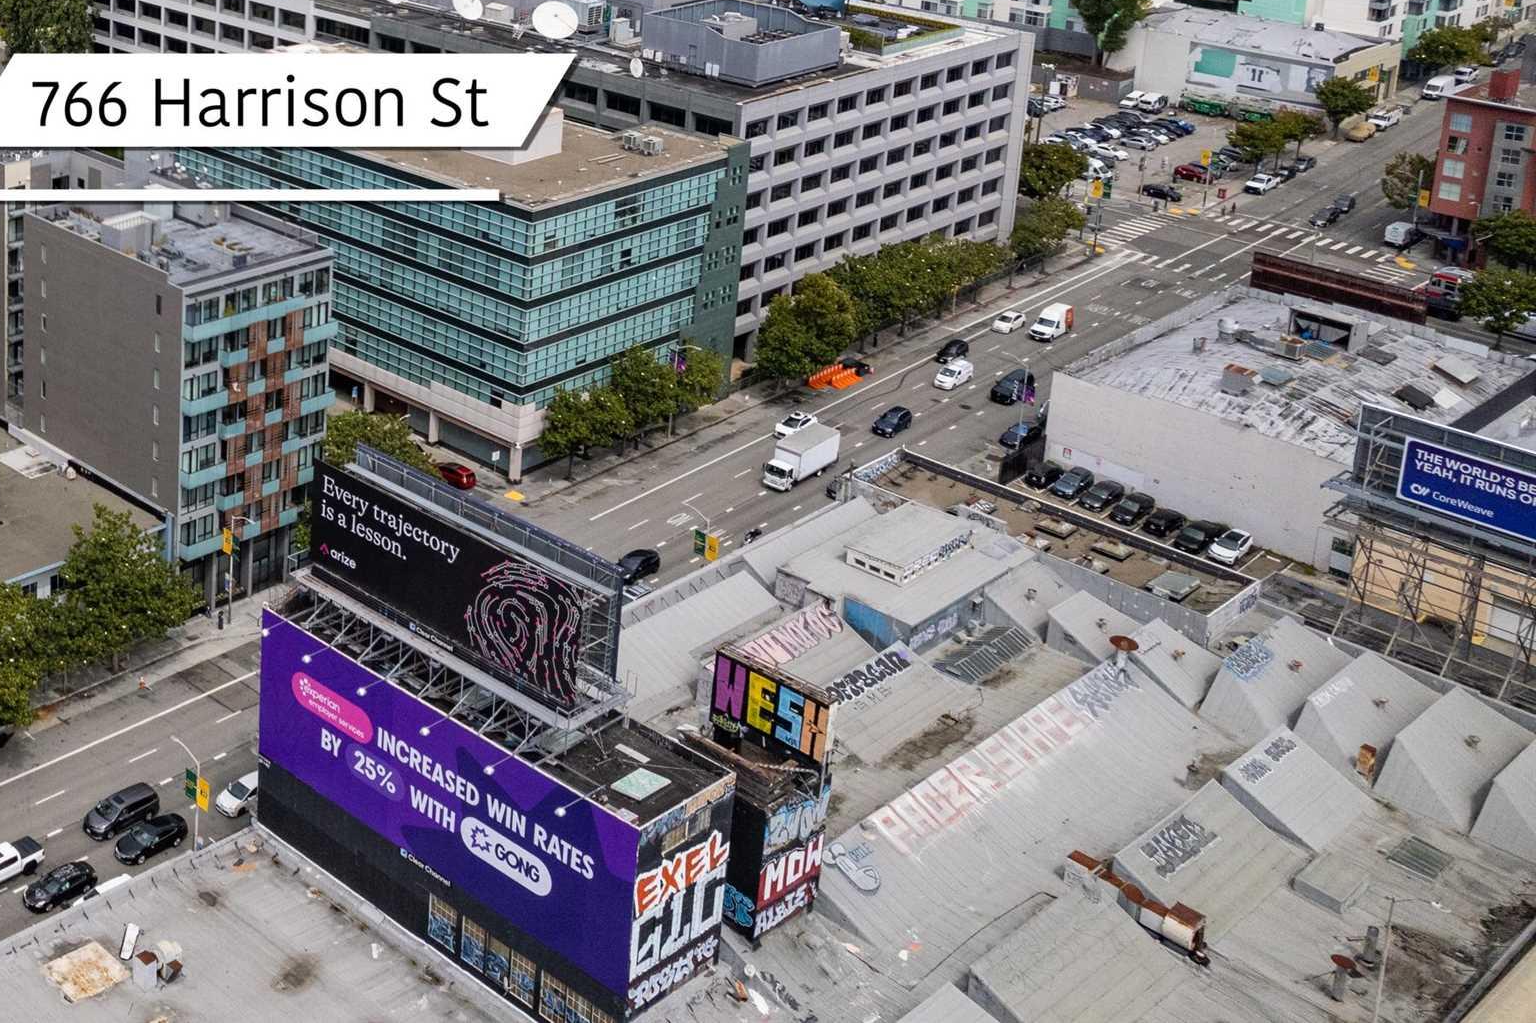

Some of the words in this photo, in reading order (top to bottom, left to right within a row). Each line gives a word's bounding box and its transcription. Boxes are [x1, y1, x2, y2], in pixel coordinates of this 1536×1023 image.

[1415, 449, 1443, 466] THE
[1445, 458, 1516, 488] WORLD'S
[1415, 459, 1456, 483] YEAH,
[1460, 474, 1474, 486] IT
[1475, 479, 1517, 501] RUNS
[320, 499, 336, 519] is
[337, 510, 347, 524] a
[351, 507, 407, 561] lesson.
[323, 475, 369, 518] Every
[373, 503, 460, 564] trajectory
[1432, 491, 1495, 518] CoreWeave
[330, 548, 357, 570] arize
[304, 685, 340, 714] experian
[714, 655, 830, 765] WESH
[320, 728, 342, 758] BY
[353, 750, 397, 795] 25%
[410, 785, 456, 834] WITH
[377, 727, 480, 807] INCREASED
[487, 795, 526, 838] WIN
[533, 822, 595, 881] RATES
[495, 843, 541, 884] GONG
[635, 829, 730, 919] EXEL
